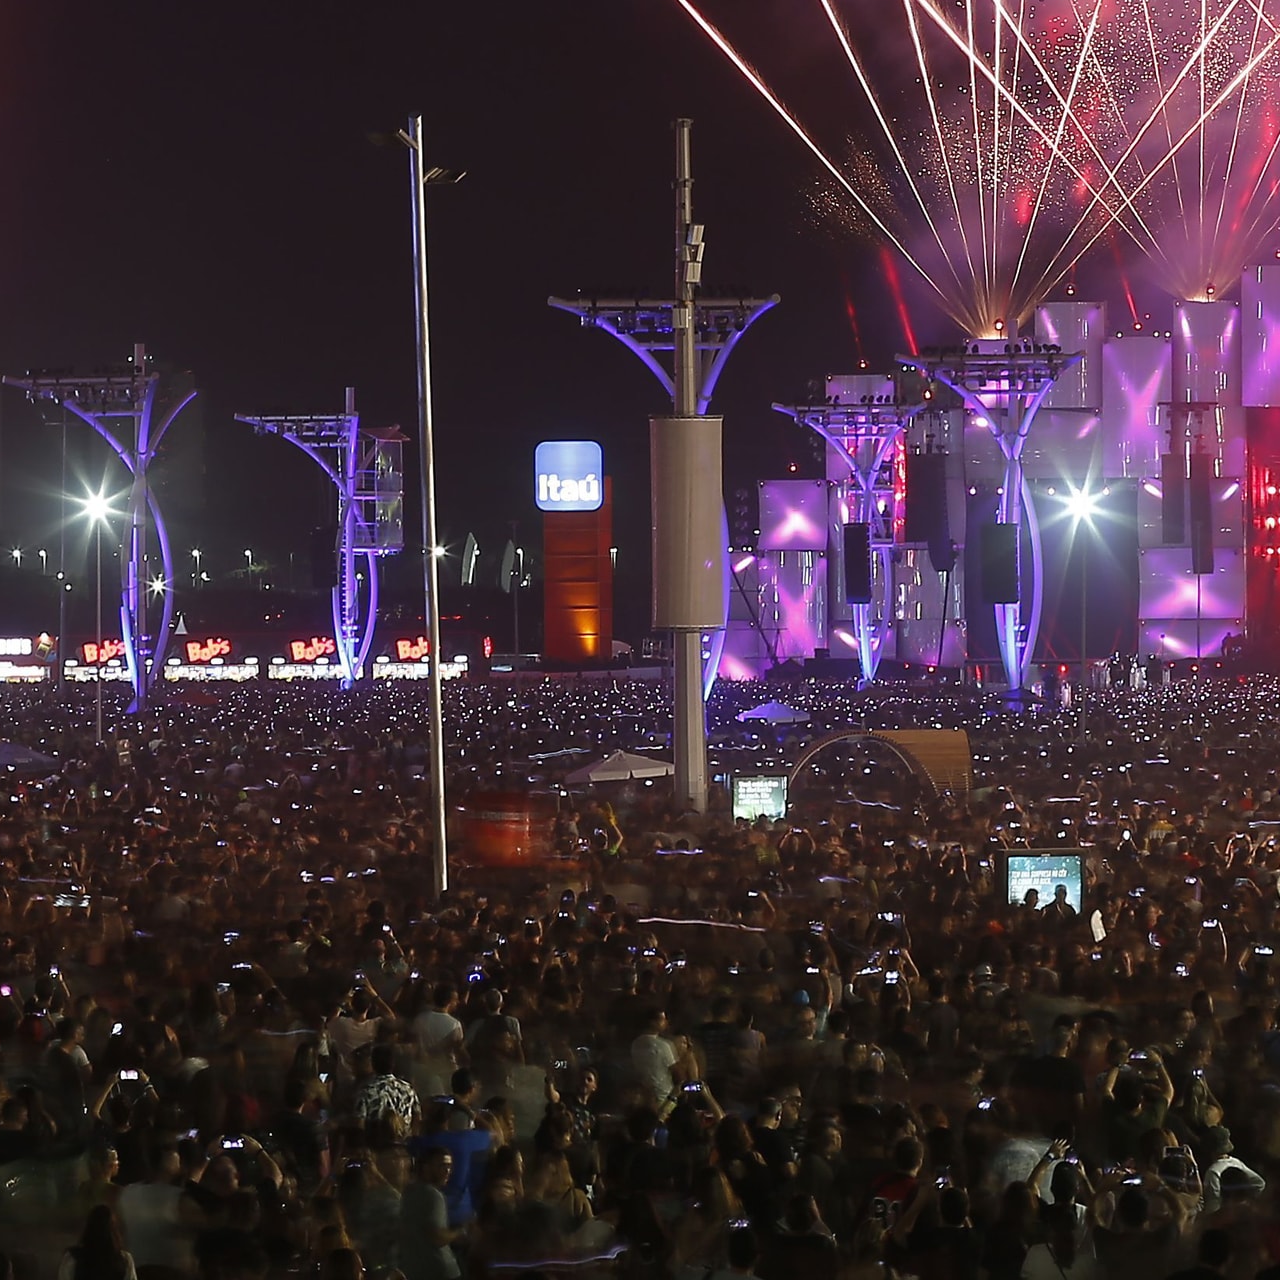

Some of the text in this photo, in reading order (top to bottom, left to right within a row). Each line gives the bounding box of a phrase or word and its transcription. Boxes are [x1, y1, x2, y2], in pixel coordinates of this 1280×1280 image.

[538, 473, 600, 502] Itaú
[186, 637, 231, 662] Bob's
[290, 637, 336, 662] Bob's
[396, 636, 429, 660] Bob
